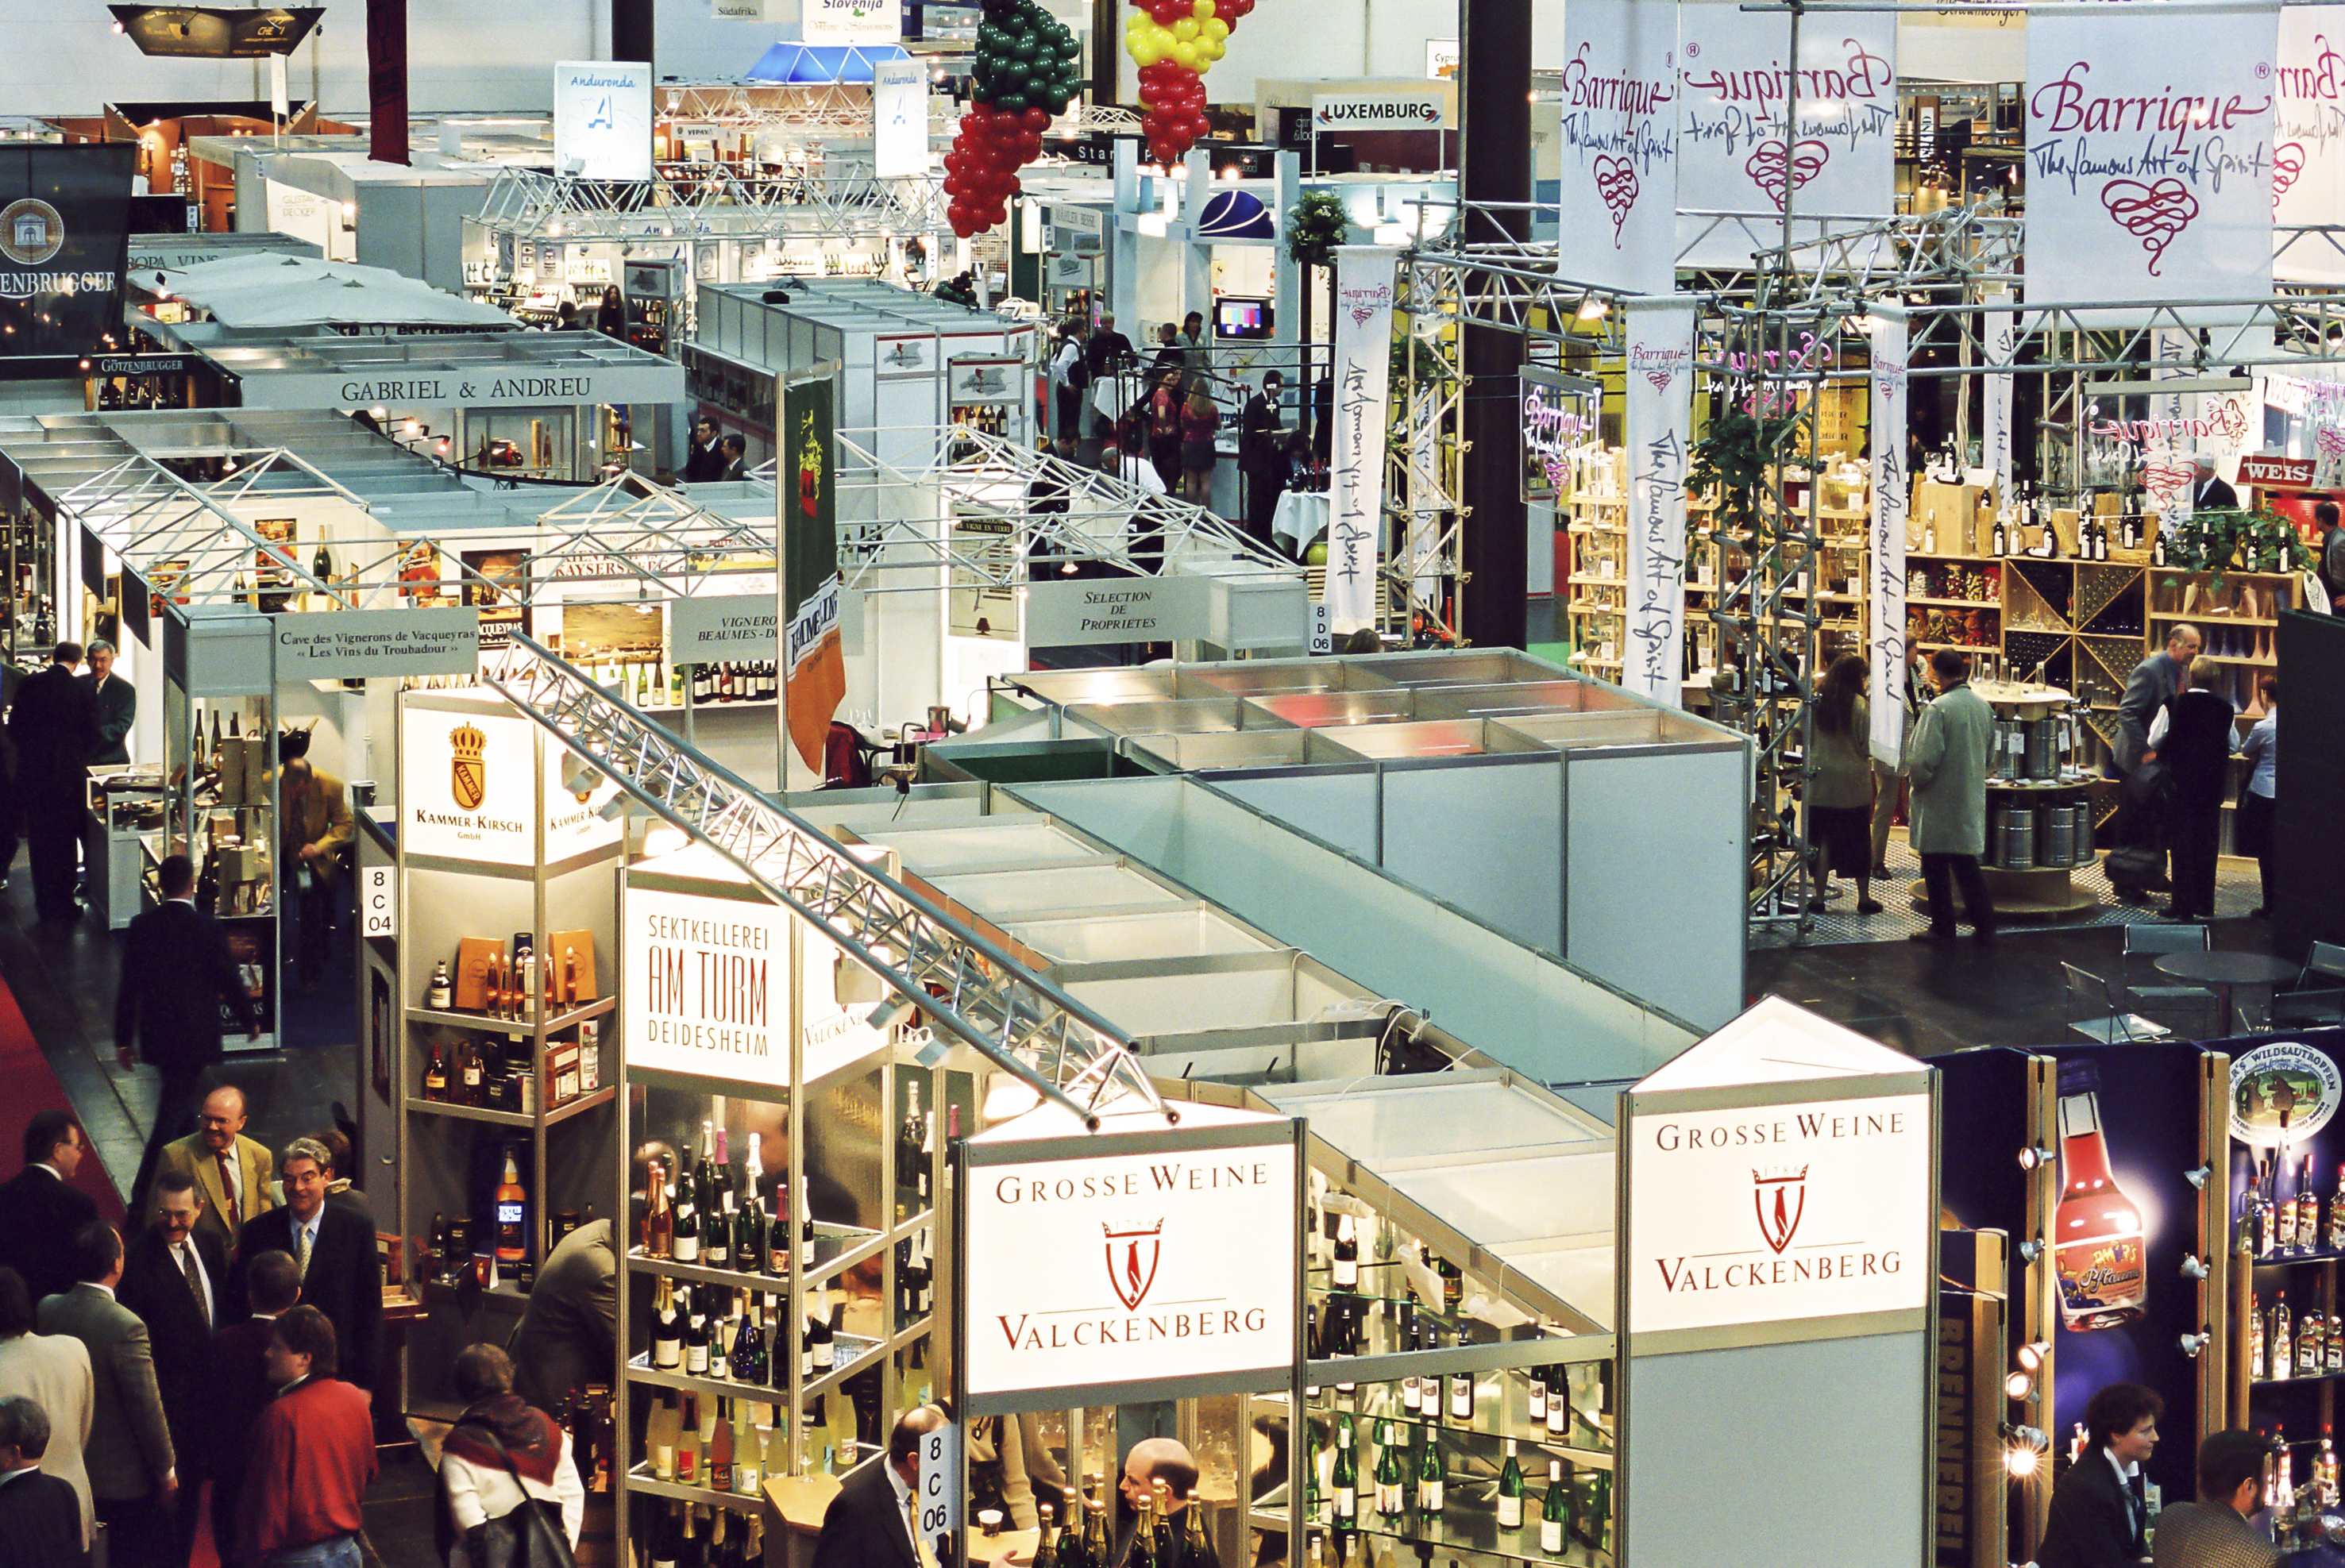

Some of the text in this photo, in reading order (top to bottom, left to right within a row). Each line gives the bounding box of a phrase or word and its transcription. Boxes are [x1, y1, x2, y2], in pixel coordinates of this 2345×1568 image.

[718, 6, 758, 16] Südafrika
[1435, 53, 1458, 64] Cypru
[1563, 42, 1674, 136] Barrique
[1325, 103, 1433, 119] LUXEMBURG
[2031, 61, 2270, 154] Barrique
[2176, 144, 2200, 185] of
[128, 256, 167, 269] ROPA
[1629, 341, 1691, 366] Barrique
[102, 360, 183, 373] GÖTZENBRUGGER
[341, 378, 592, 402] GABRIEL & ANDREU
[2243, 463, 2308, 482] WEIS
[1083, 591, 1152, 604] SELECTION
[1110, 606, 1126, 614] DE
[1317, 607, 1325, 618] 8
[478, 622, 523, 637] ACQUEYRAS
[722, 616, 777, 628] VIGNERO
[1317, 622, 1326, 634] D
[280, 632, 310, 645] Cave
[313, 633, 331, 645] des
[335, 632, 392, 645] Vignerons
[395, 631, 408, 641] de
[411, 630, 475, 644] Vacqueyras
[1313, 638, 1329, 651] 06
[310, 645, 331, 657] Les
[335, 646, 361, 657] Vins
[364, 645, 379, 656] du
[382, 644, 446, 655] Troubadour
[456, 764, 481, 800] KAMMER
[417, 809, 523, 833] KAMMER-KIRSCH
[550, 804, 604, 831] KAMMER-KIR
[457, 832, 481, 841] GmbH
[373, 872, 385, 888] 8
[372, 894, 386, 910] C
[368, 916, 392, 931] 04
[649, 915, 769, 950] SEKTKELLEREI
[696, 950, 767, 1027] TURM
[649, 1019, 769, 1057] DEIDESHEIM
[804, 1010, 867, 1046] VALCKENB
[2251, 1046, 2336, 1091] WILDSAUTROPFEN
[1657, 1112, 1904, 1152] GROSSE WEINE
[997, 1162, 1267, 1204] GROSSE WEINE
[1656, 1251, 1900, 1293] VALCKENBERG
[997, 1307, 1266, 1350] VALCKENBERG
[931, 1437, 942, 1461] 8
[928, 1474, 942, 1497] C
[923, 1504, 947, 1532] 06
